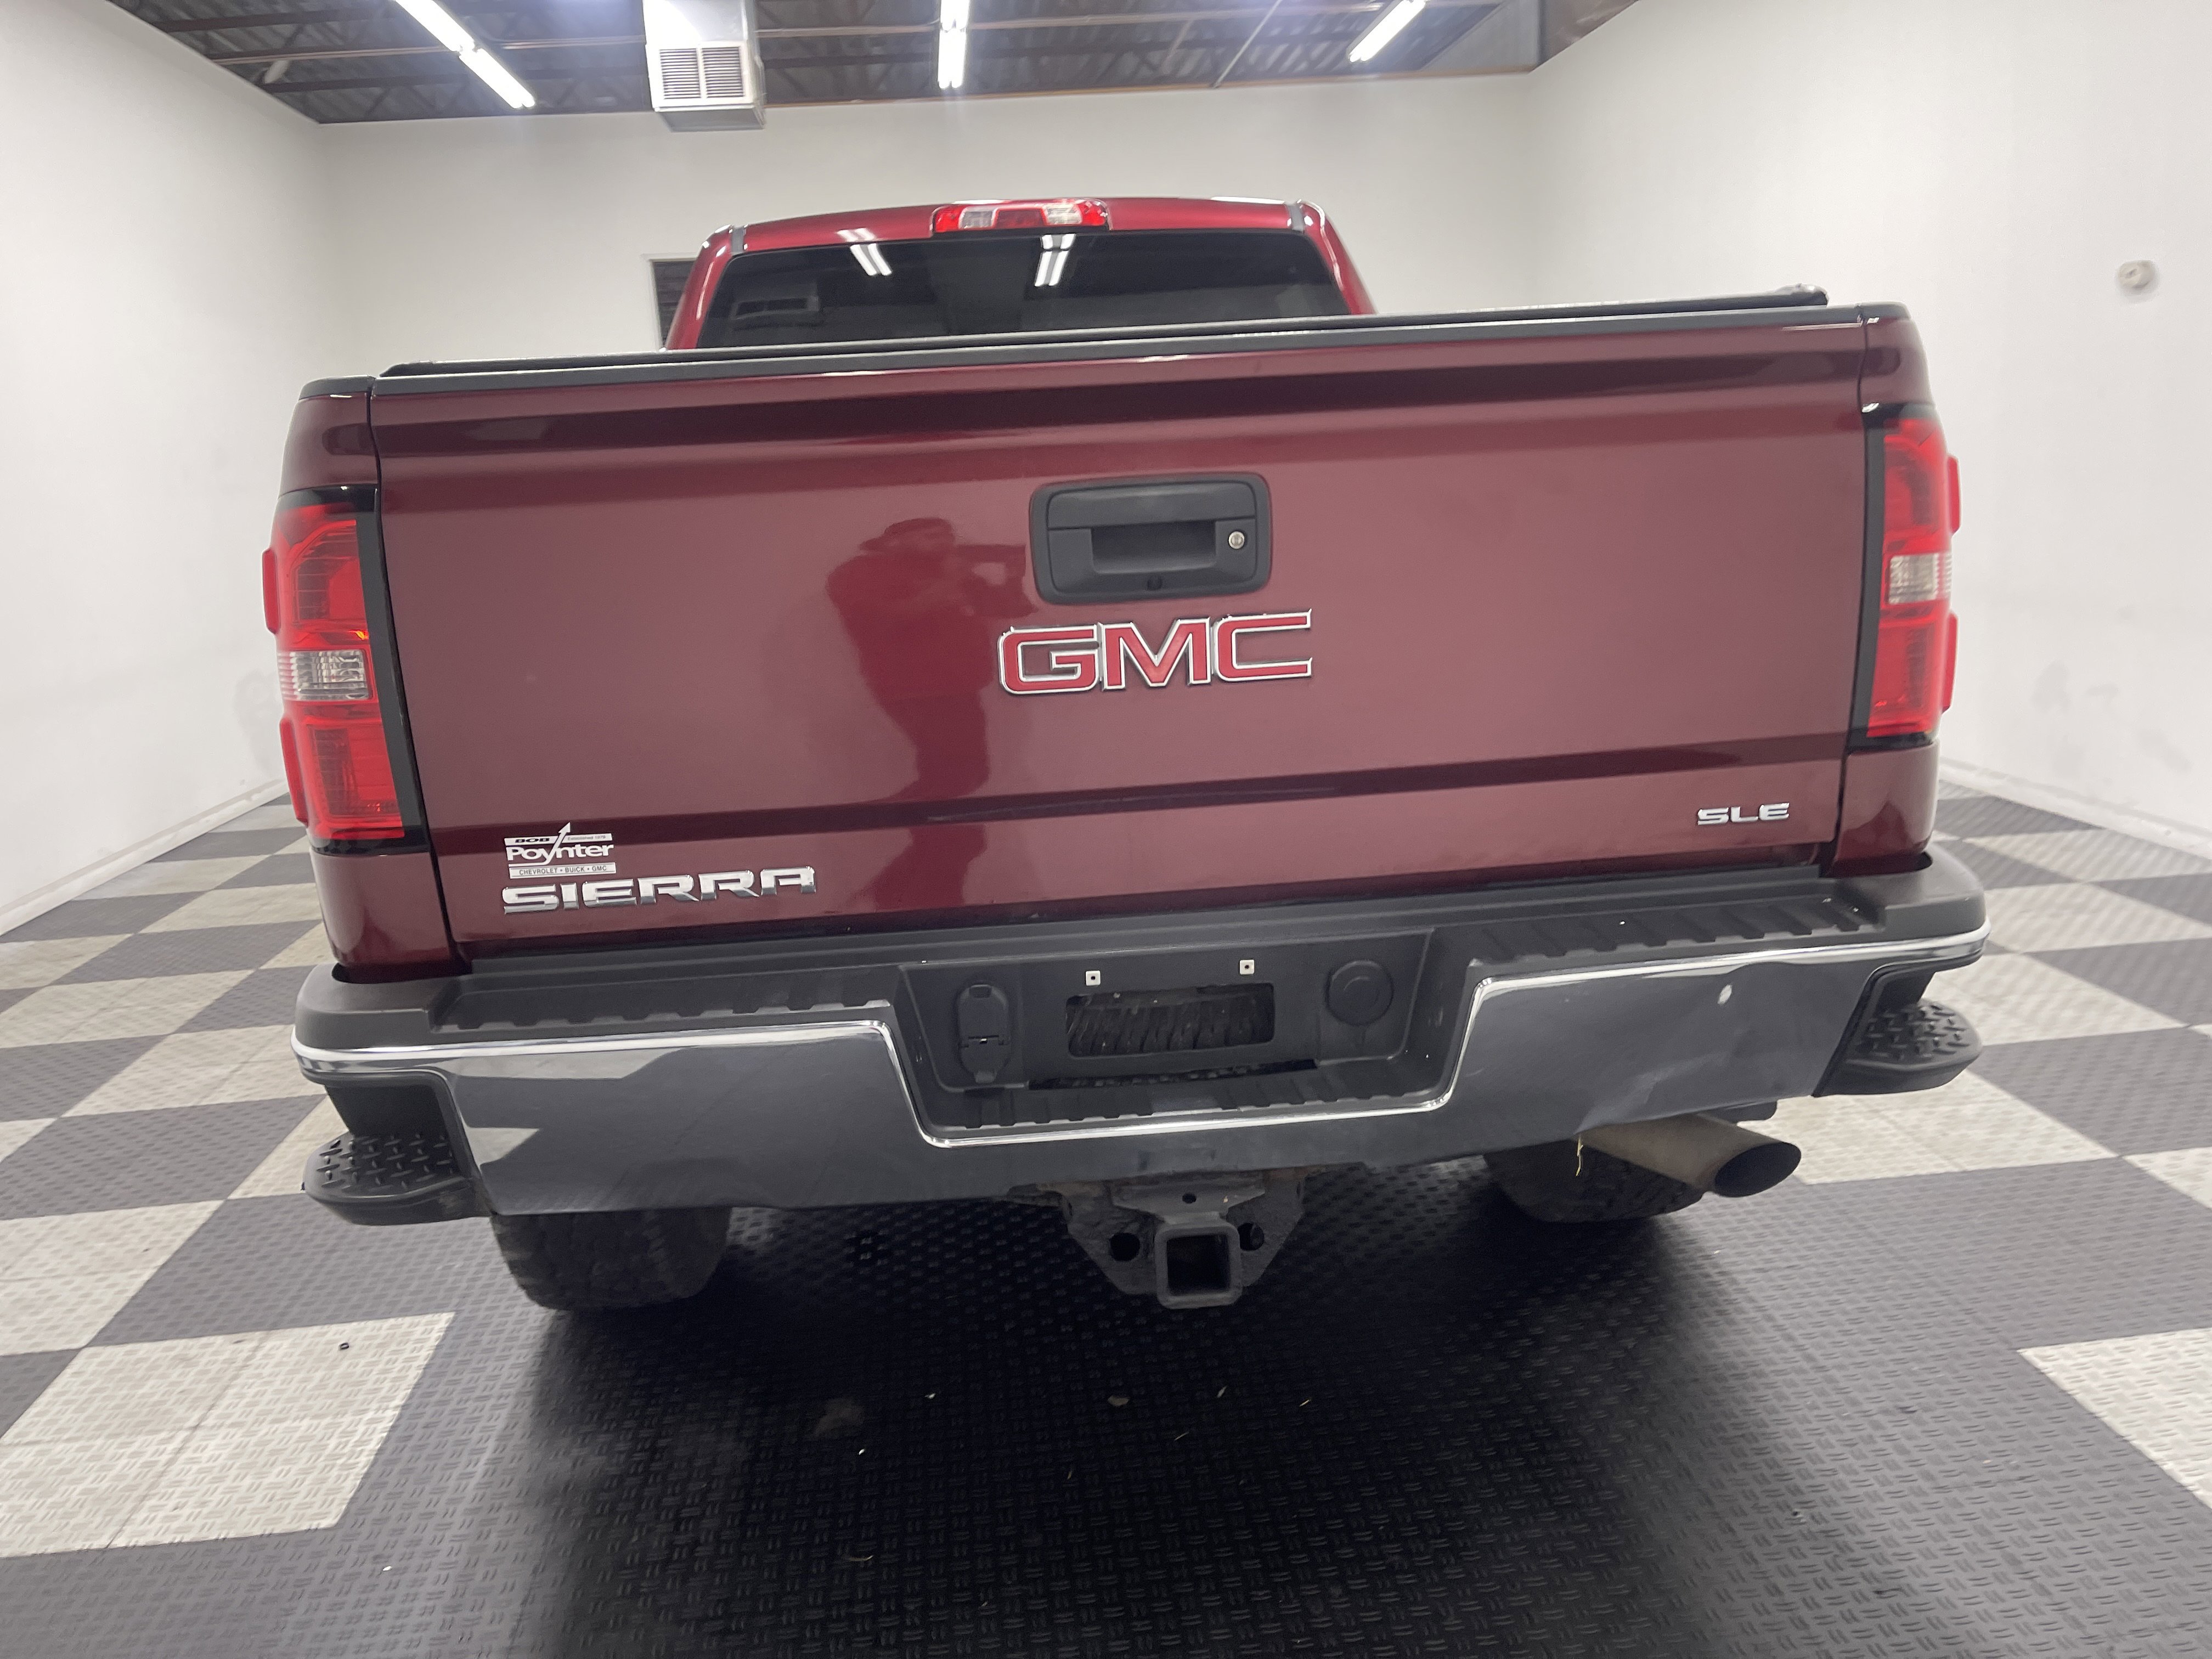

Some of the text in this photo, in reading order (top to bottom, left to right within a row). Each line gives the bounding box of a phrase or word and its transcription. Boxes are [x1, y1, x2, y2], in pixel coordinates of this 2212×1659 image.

[998, 608, 1312, 695] GMC
[1697, 803, 1790, 826] SLE
[505, 844, 614, 865] Poynter
[519, 867, 558, 876] CHEVROLET
[501, 866, 816, 915] SIERRA
